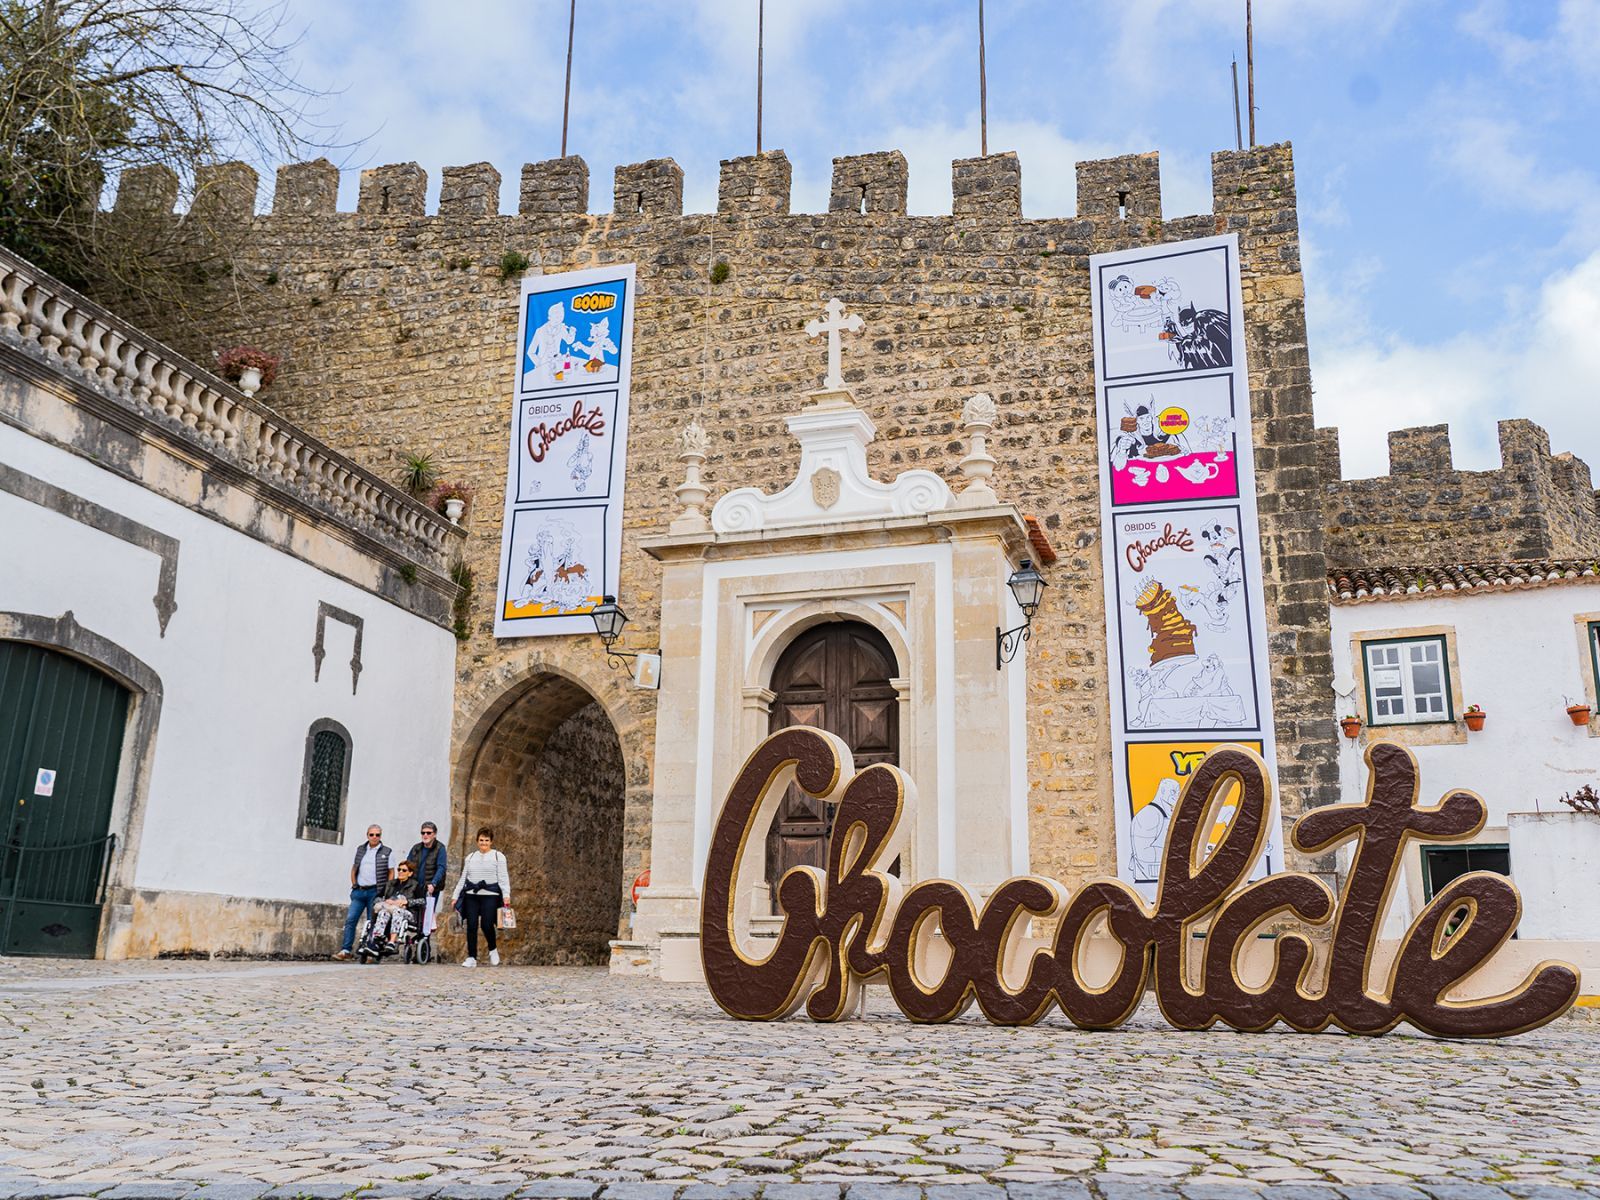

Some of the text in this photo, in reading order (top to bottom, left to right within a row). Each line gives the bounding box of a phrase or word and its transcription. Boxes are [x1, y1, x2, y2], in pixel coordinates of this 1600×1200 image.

[573, 293, 615, 311] BOOM!
[527, 400, 606, 463] Chocolate
[1126, 522, 1194, 573] Chocolate
[1170, 751, 1206, 776] YE
[700, 726, 1581, 1040] Chocolate
